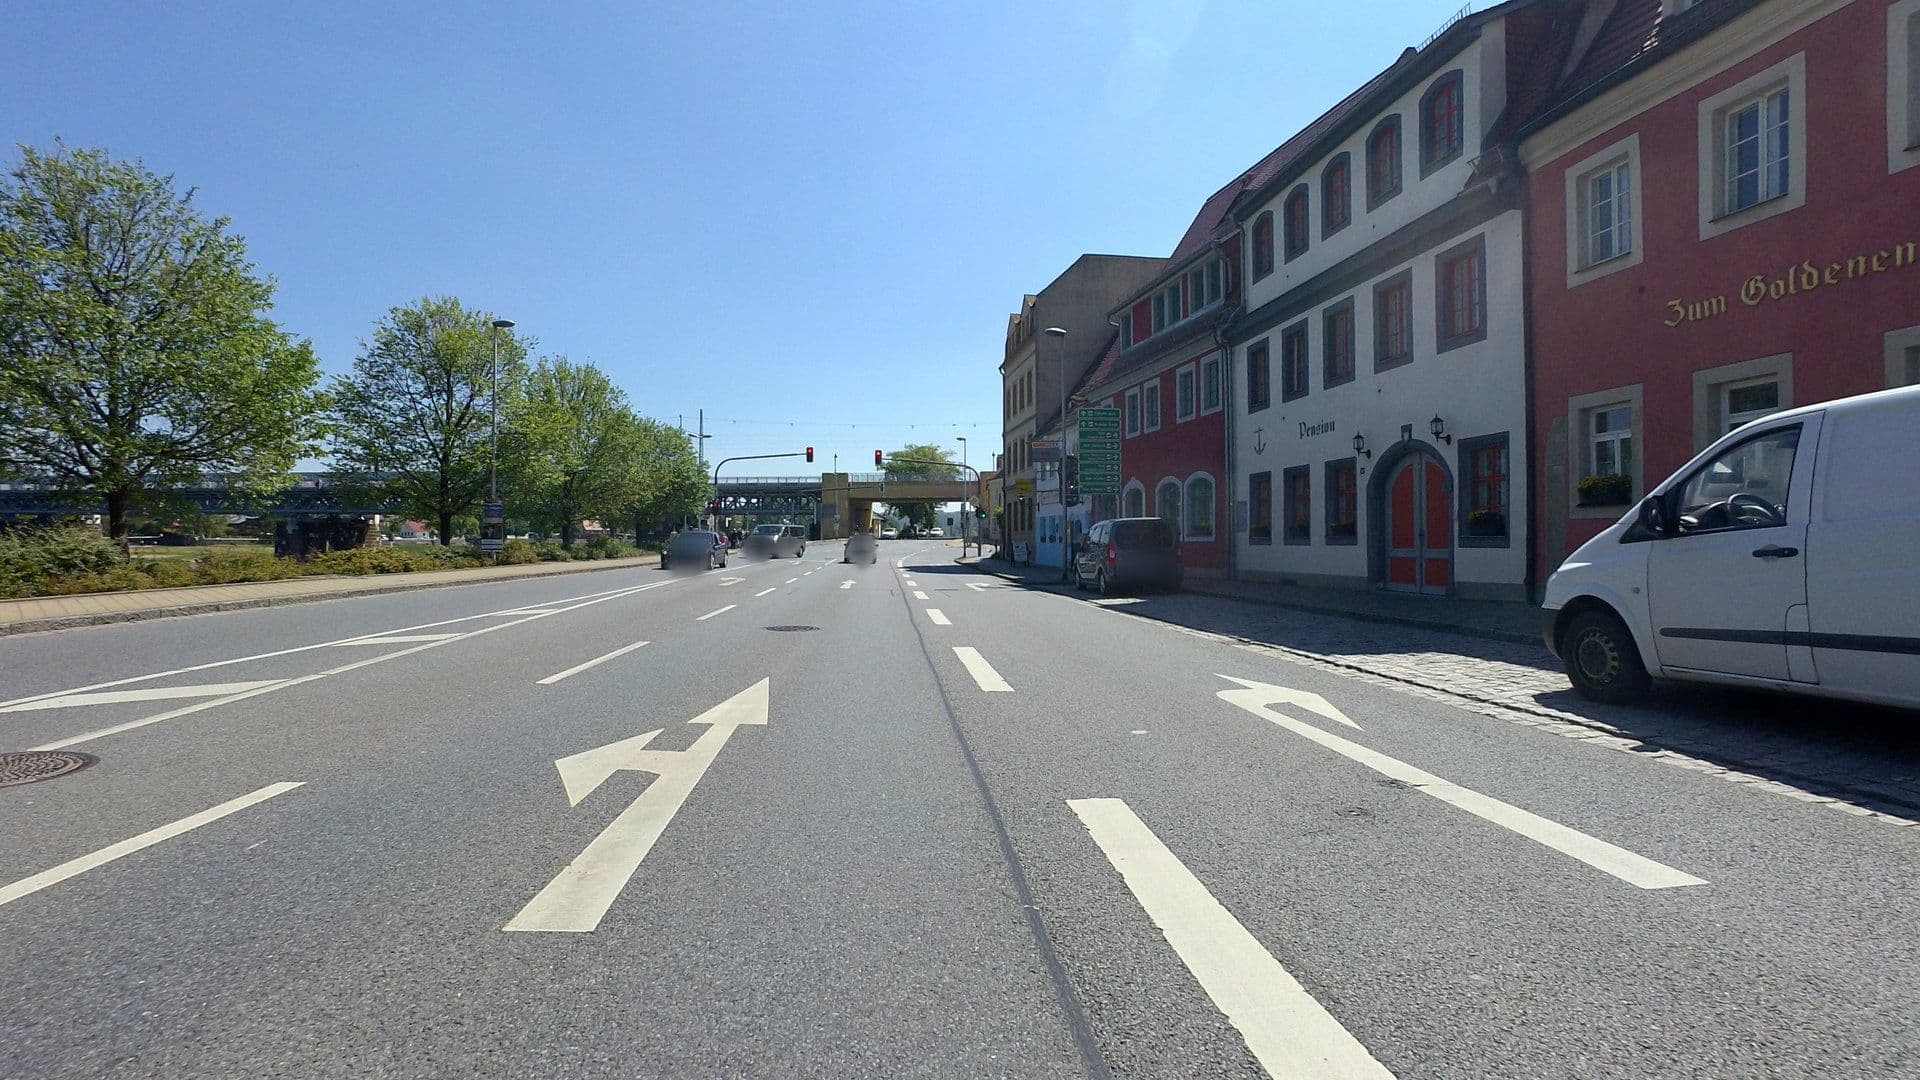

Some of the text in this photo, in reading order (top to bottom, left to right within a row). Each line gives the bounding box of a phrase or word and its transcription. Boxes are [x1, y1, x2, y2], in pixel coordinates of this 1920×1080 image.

[1663, 242, 1916, 328] Zum Goldenen
[1299, 419, 1336, 440] Pension
